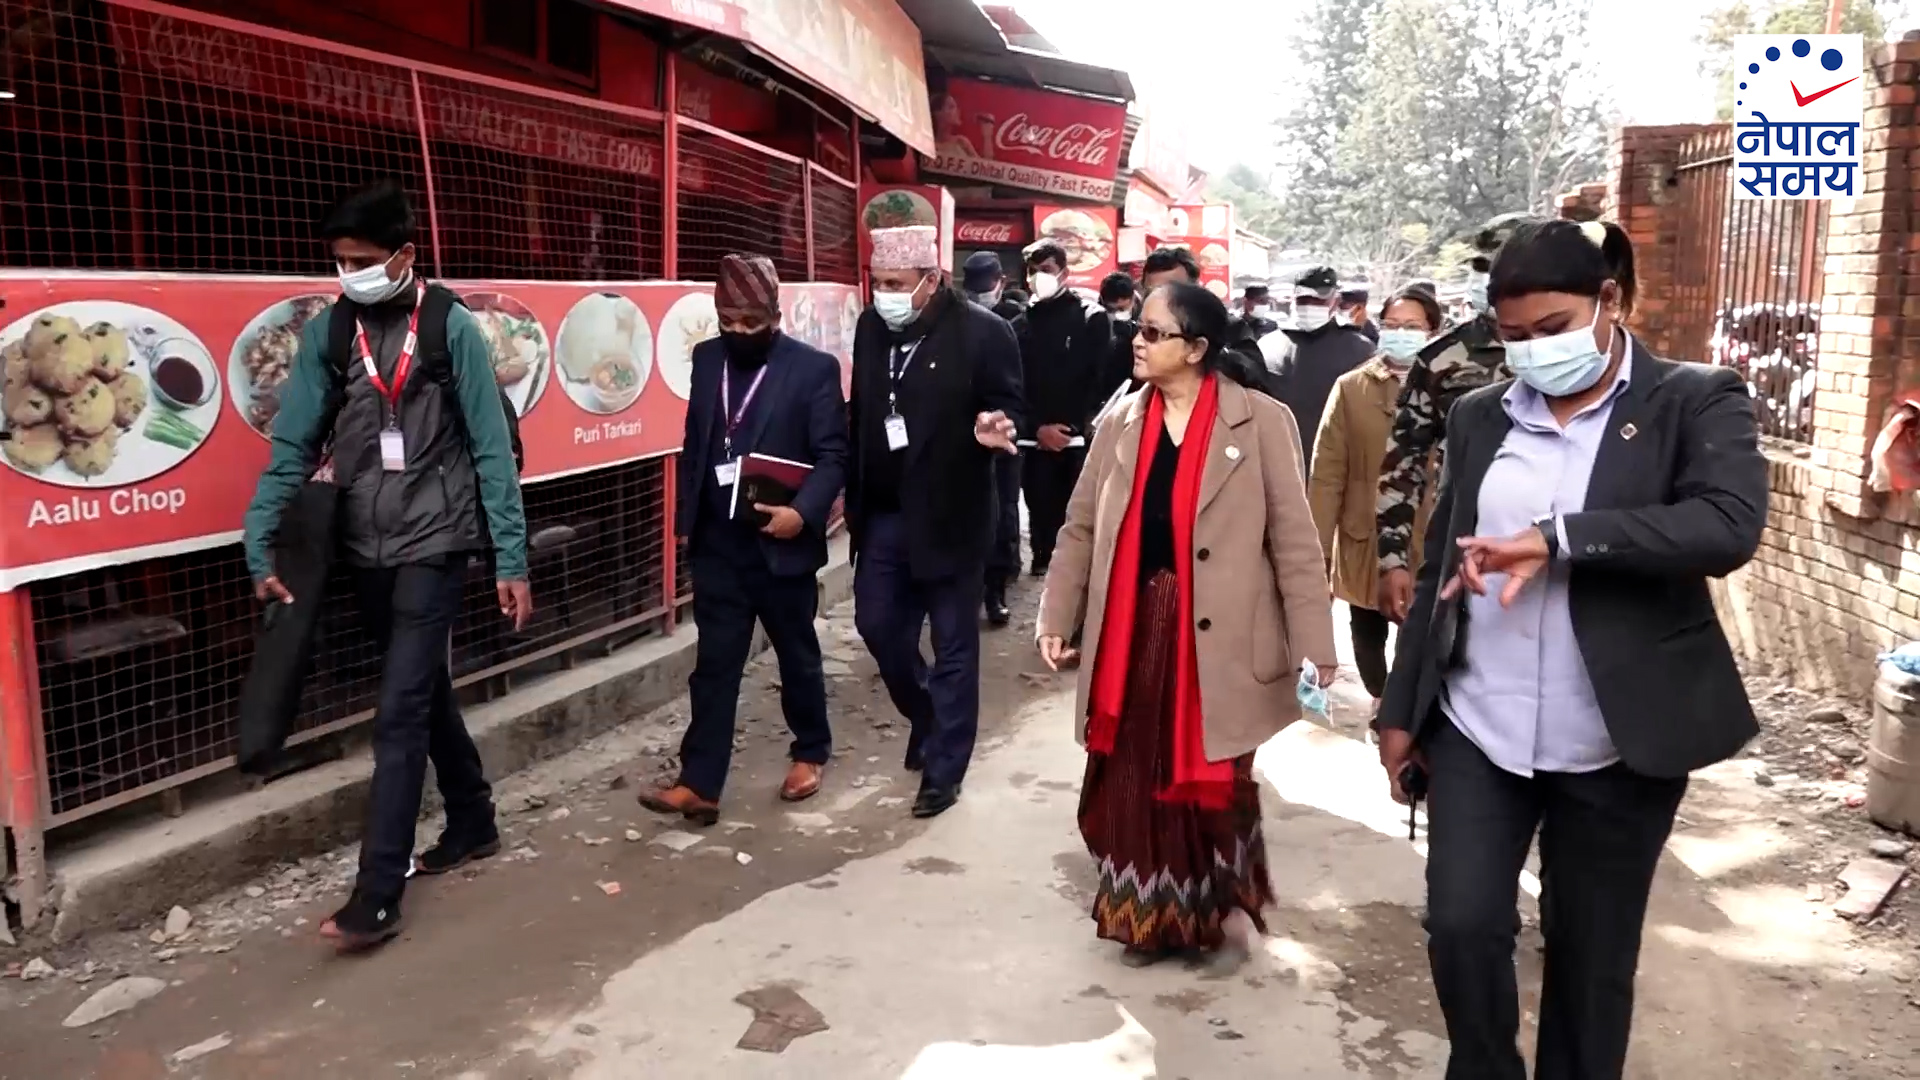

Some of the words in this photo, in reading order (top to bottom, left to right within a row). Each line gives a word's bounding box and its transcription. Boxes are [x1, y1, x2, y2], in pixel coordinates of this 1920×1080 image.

[439, 97, 543, 153] QUALITY
[556, 125, 601, 163] FAST
[604, 137, 653, 175] FOOD
[995, 112, 1119, 166] Coca-Cola
[971, 160, 1005, 181] Dhital
[1008, 167, 1049, 190] Quality
[1052, 173, 1078, 192] Fast
[1080, 180, 1112, 199] Food
[573, 423, 600, 445] Puri
[602, 418, 642, 440] Tarkari
[27, 496, 100, 528] Aalu
[109, 487, 187, 514] Chop
